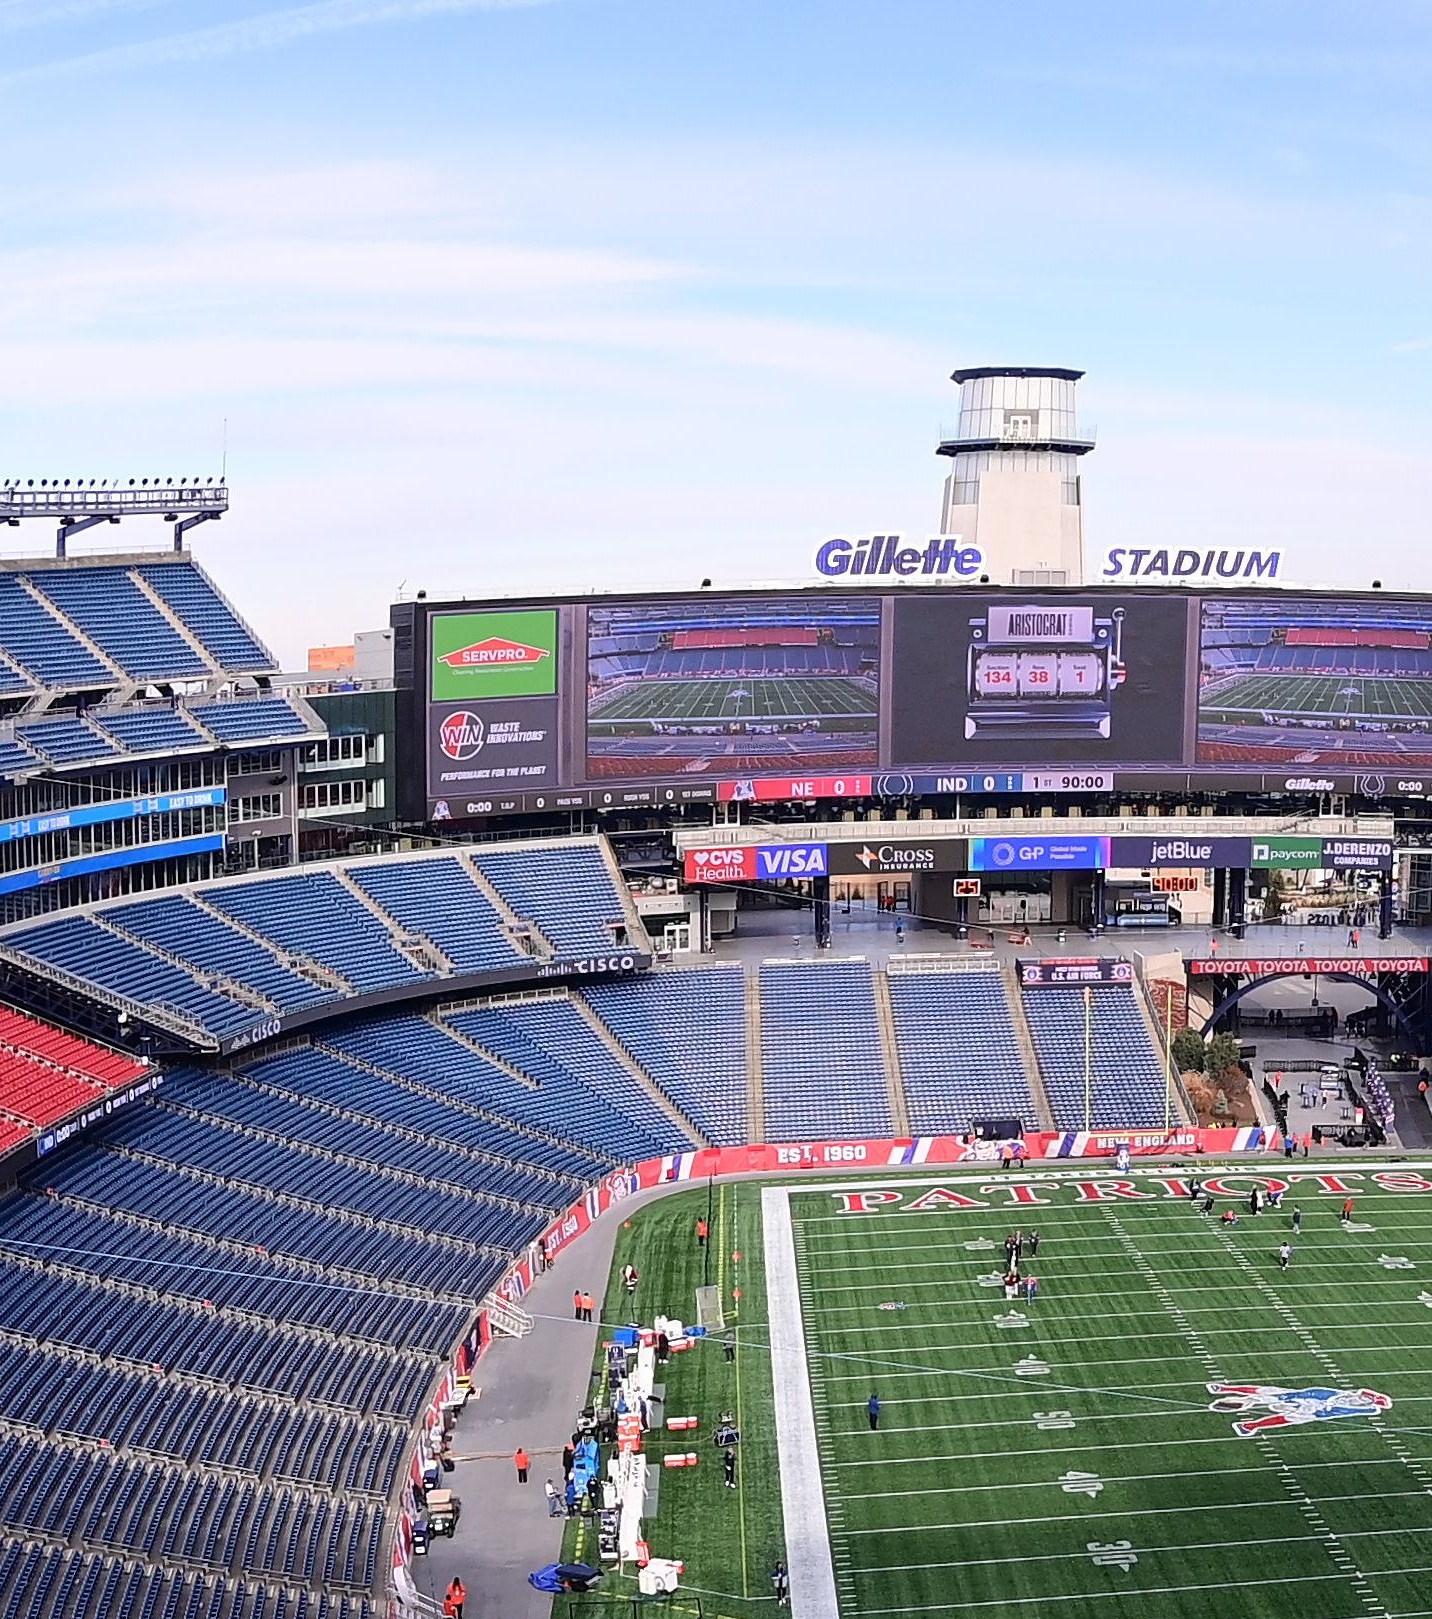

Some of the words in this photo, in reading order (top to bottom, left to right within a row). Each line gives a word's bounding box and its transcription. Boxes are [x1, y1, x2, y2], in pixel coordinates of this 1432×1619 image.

[815, 535, 982, 576] Gillette
[1103, 548, 1280, 578] STADIUM
[1008, 614, 1067, 636] ARISTOCRAT
[462, 648, 527, 663] SERVPRO
[984, 671, 1011, 684] 134
[1028, 671, 1048, 683] 38
[1076, 671, 1083, 683] 1
[791, 782, 813, 796] NE
[834, 781, 845, 795] 0
[937, 777, 967, 792] IND
[983, 776, 995, 791] 0
[1061, 776, 1104, 789] 90:00
[604, 793, 612, 803] 0
[666, 790, 673, 800] 0
[467, 801, 492, 813] 0:00
[536, 798, 545, 808] 0
[709, 849, 744, 865] CVS
[1151, 841, 1212, 863] jetBlue
[1270, 850, 1320, 861] paycom
[759, 848, 826, 873] VISA
[577, 956, 634, 973] CISCO
[1198, 961, 1251, 973] TOYOTA
[1256, 961, 1309, 973] TOYOTA
[1314, 960, 1367, 972] TOYOTA
[1371, 959, 1424, 972] TOYOTA
[252, 1019, 282, 1042] CISCO
[1134, 1134, 1195, 1147] ENGLAND
[824, 1145, 867, 1161] 1960
